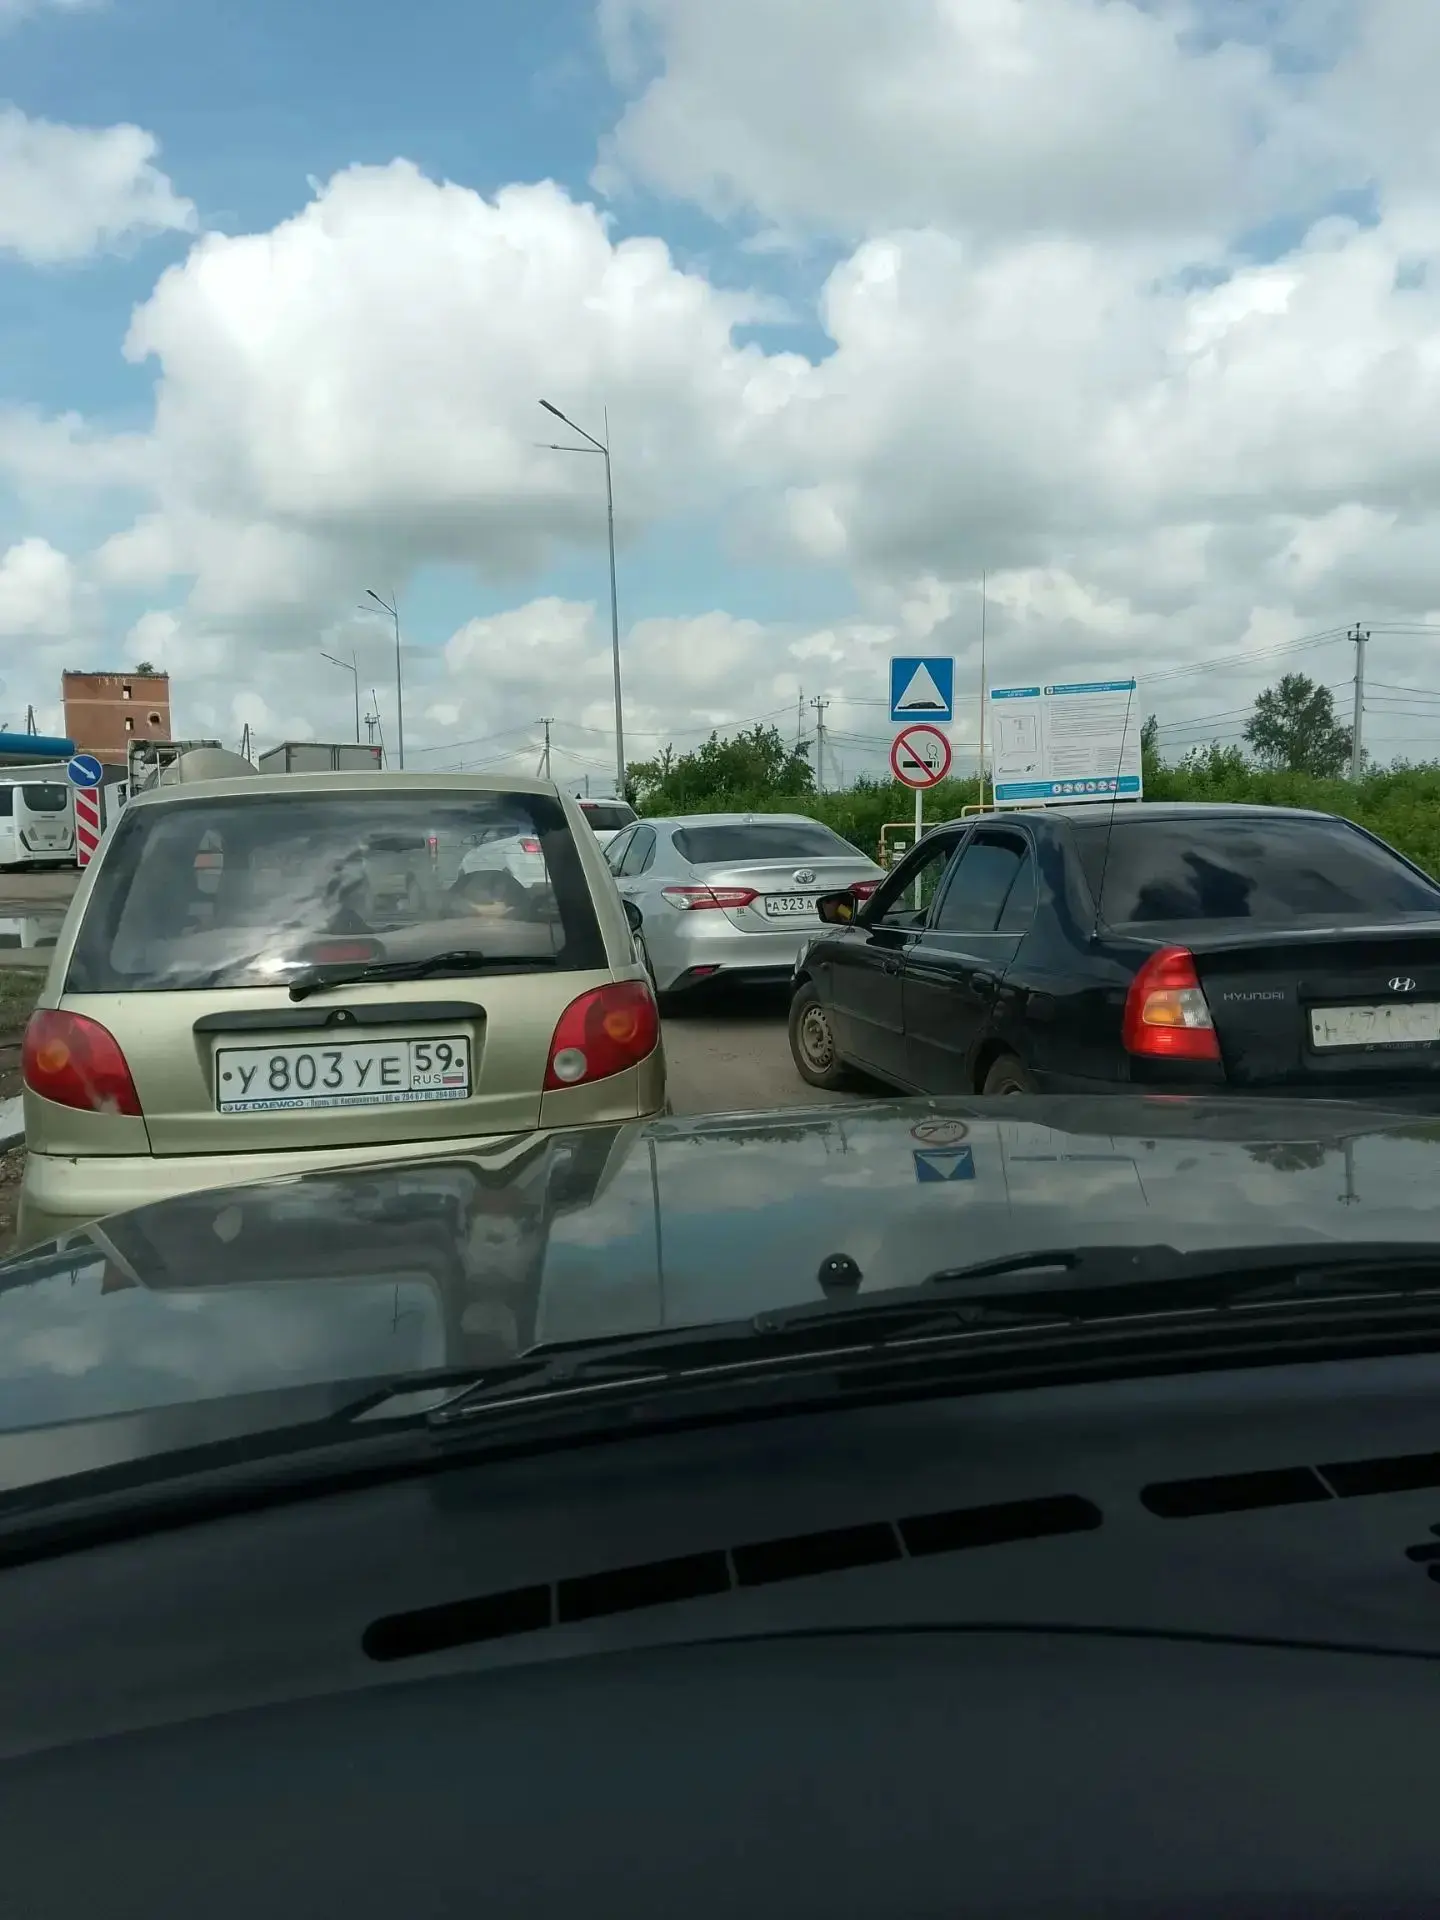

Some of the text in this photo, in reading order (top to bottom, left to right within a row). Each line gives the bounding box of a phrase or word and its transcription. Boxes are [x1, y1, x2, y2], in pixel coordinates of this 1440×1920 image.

[772, 897, 818, 912] А323А
[1223, 991, 1285, 1002] HYUNDAI
[415, 1043, 453, 1072] 59
[412, 1073, 442, 1085] RUS
